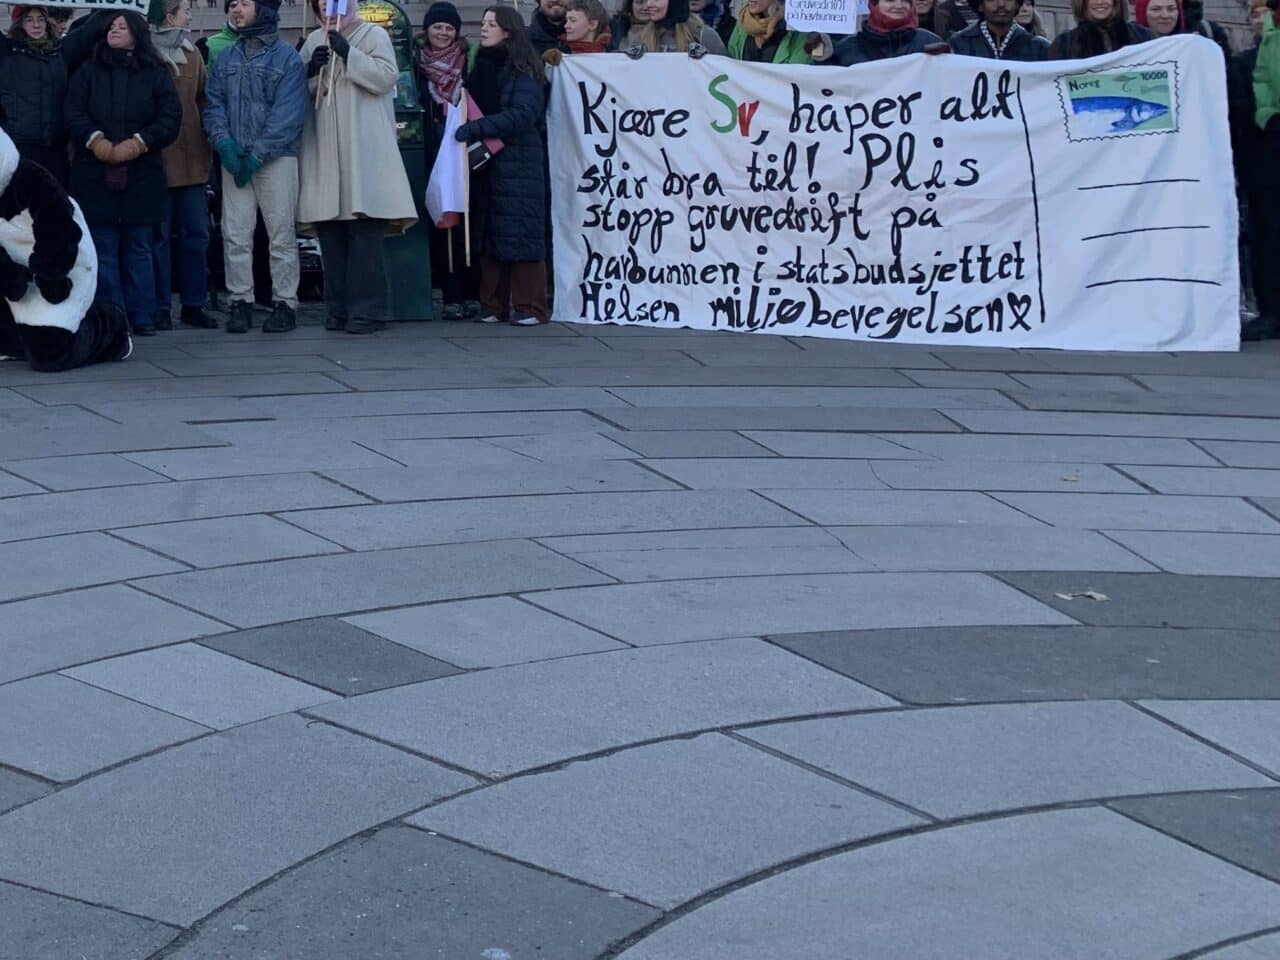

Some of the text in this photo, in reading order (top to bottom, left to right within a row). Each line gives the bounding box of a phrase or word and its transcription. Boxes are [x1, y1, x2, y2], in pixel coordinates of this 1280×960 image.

[578, 80, 690, 158] Kjære
[788, 82, 923, 155] håper
[939, 69, 1019, 122] alt
[576, 131, 980, 200] står bra til! Plis
[582, 191, 944, 257] stopp gruvedrift på
[581, 233, 1025, 296] havbunnen i statsbudsjettet
[578, 280, 681, 323] Hilsen
